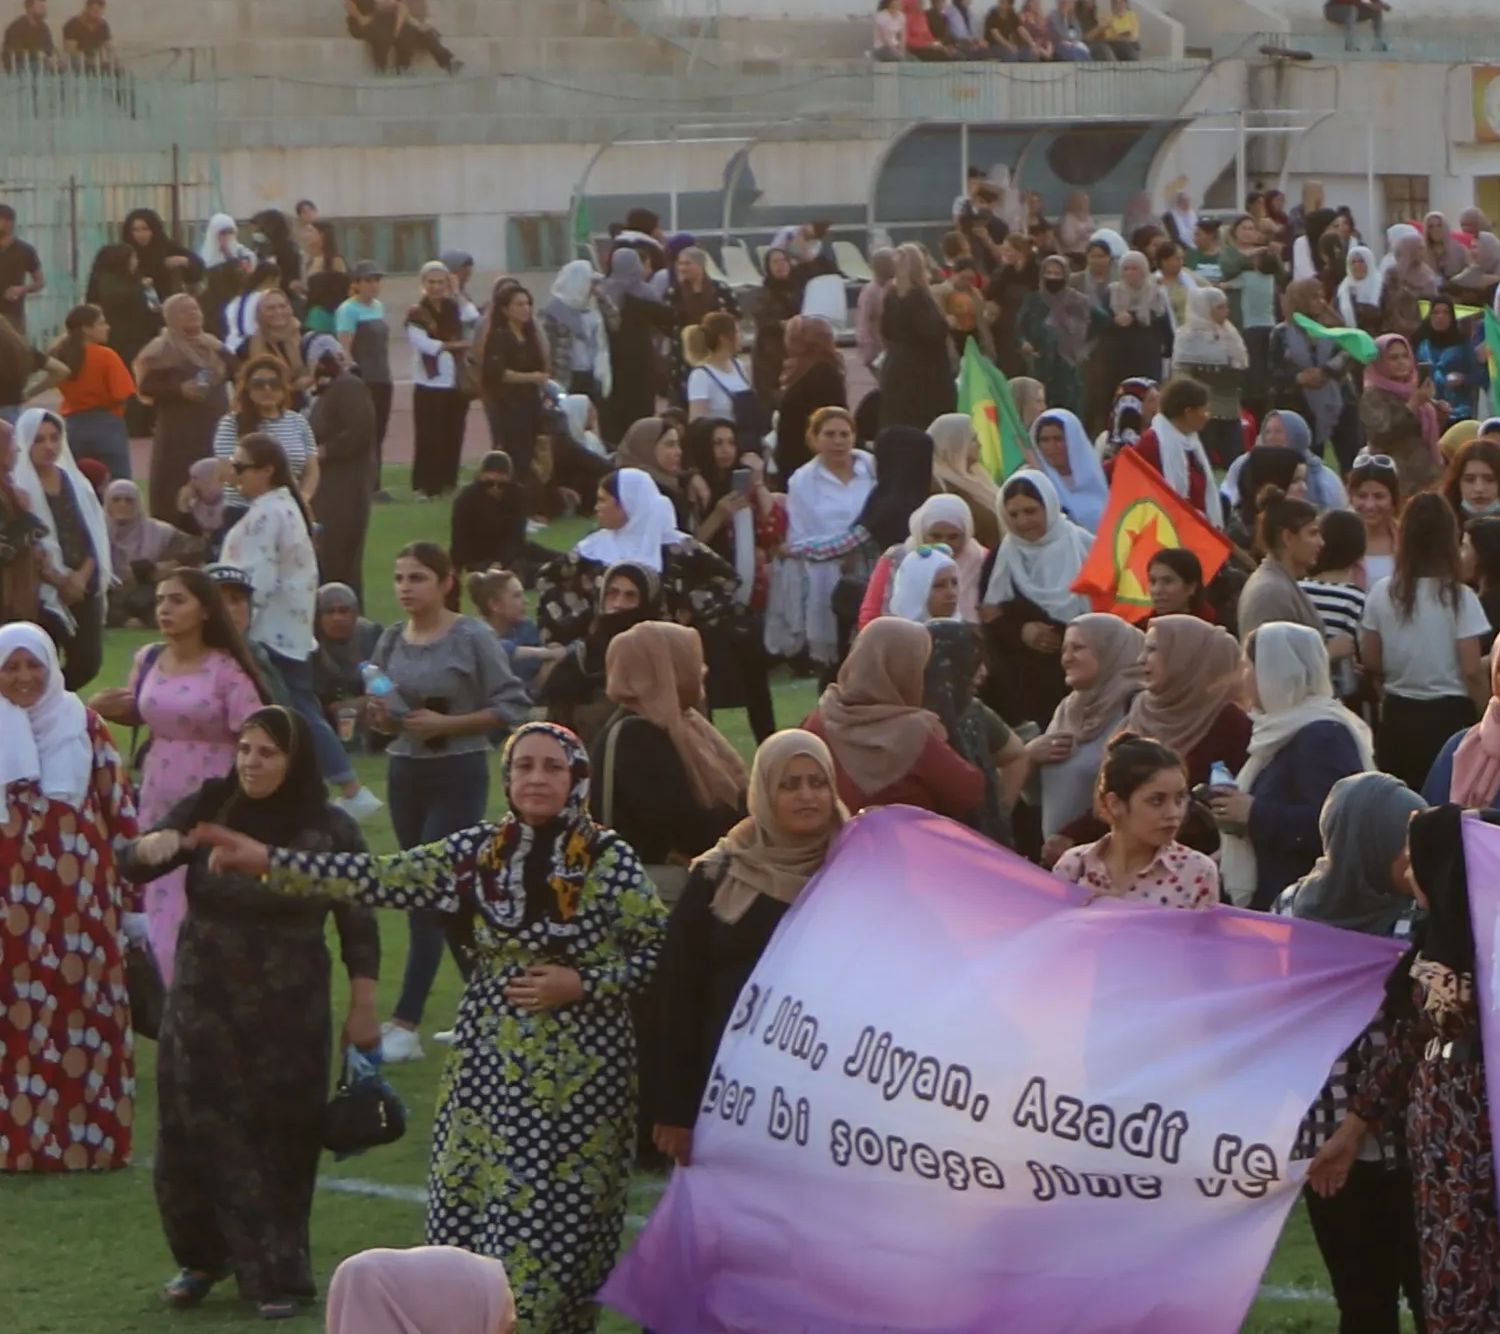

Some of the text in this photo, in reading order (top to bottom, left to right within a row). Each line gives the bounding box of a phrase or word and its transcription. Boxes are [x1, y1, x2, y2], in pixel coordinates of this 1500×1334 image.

[768, 1085, 811, 1147] bi
[829, 1118, 1005, 1191] şoreşa
[843, 1025, 989, 1122] Jiyan,
[1012, 1075, 1189, 1164] Azadî
[1211, 1132, 1281, 1181] re
